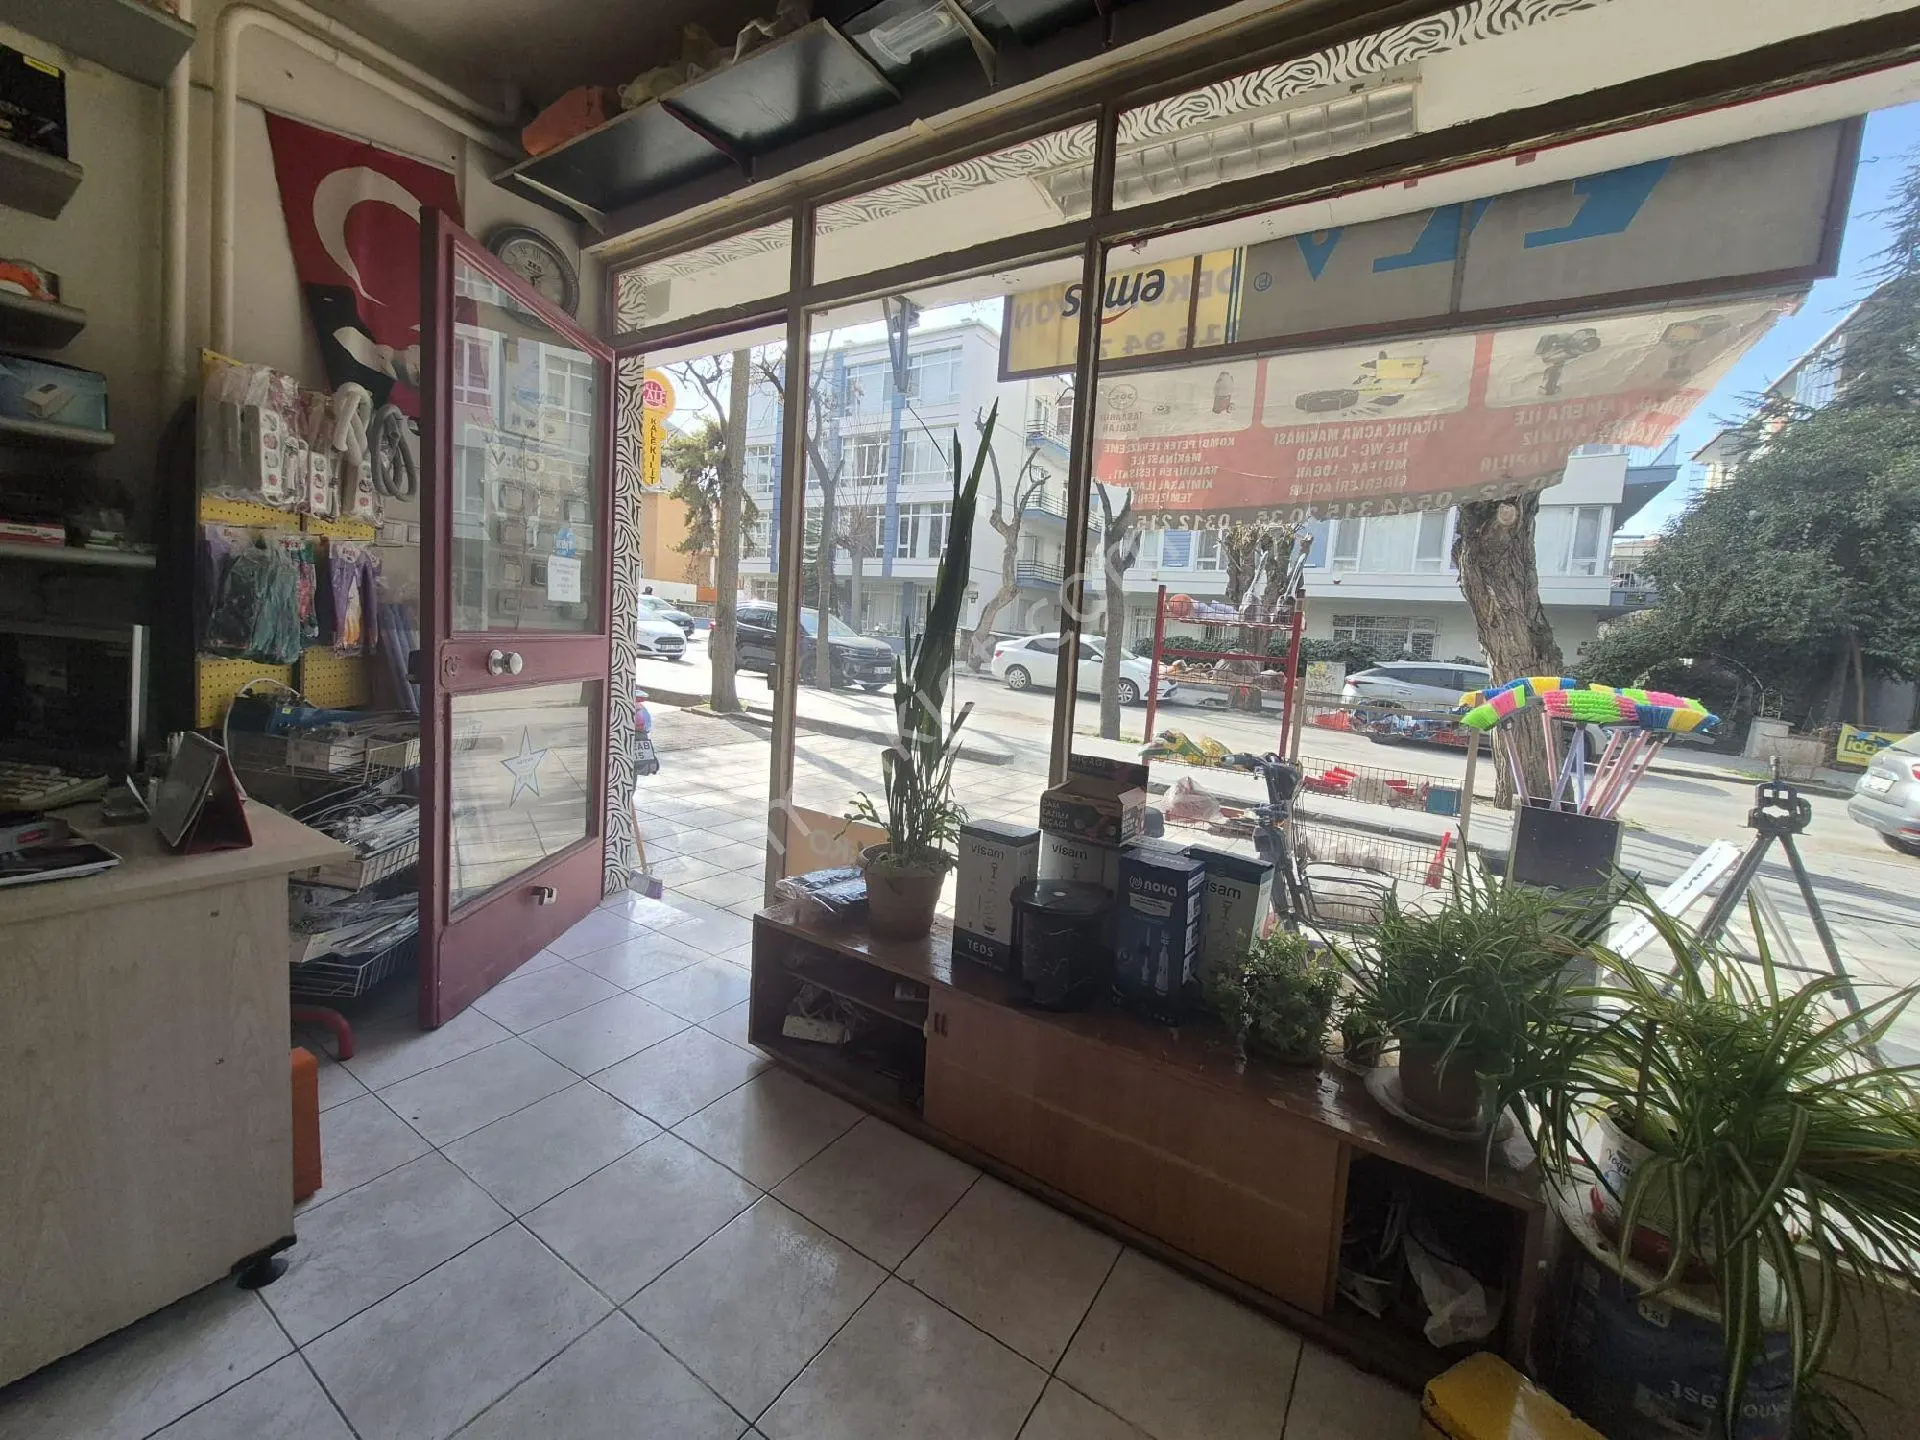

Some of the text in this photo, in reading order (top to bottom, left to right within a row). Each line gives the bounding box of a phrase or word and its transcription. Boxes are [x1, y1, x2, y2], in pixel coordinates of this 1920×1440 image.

[1062, 268, 1166, 317] ems
[971, 843, 1005, 861] visam
[1052, 844, 1088, 861] visam
[1144, 879, 1178, 899] nova
[1204, 880, 1241, 900] isam
